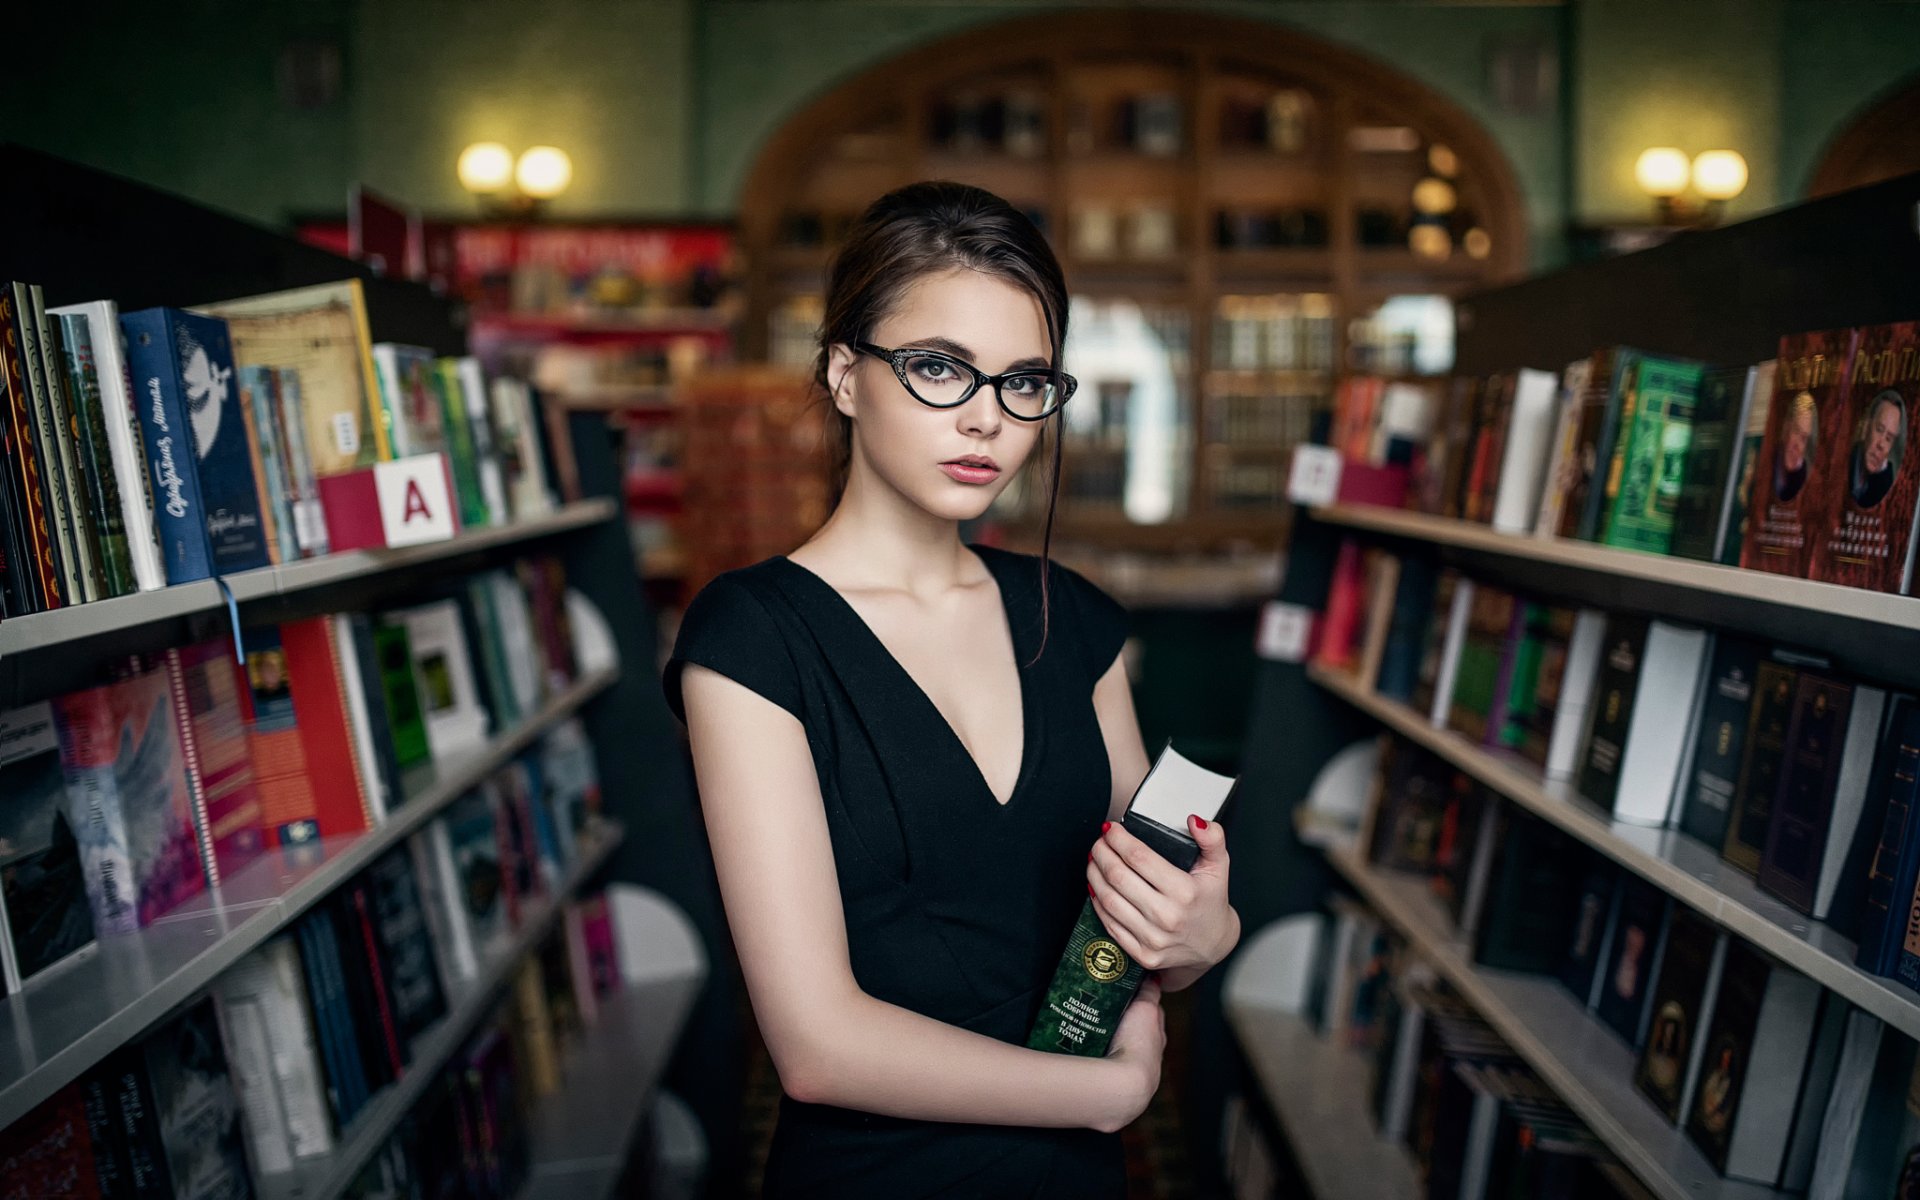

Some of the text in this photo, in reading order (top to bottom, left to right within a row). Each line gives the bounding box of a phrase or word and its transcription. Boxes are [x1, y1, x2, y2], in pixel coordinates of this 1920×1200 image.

[404, 480, 432, 522] А
[1062, 1001, 1101, 1024] СОБРАНИЕ
[1068, 996, 1100, 1016] ПОЛНОЕ
[1058, 1026, 1085, 1044] ТОМАХ
[1066, 1022, 1087, 1038] ДВУХ
[1078, 1020, 1107, 1035] ПОВЕСТЕЙ
